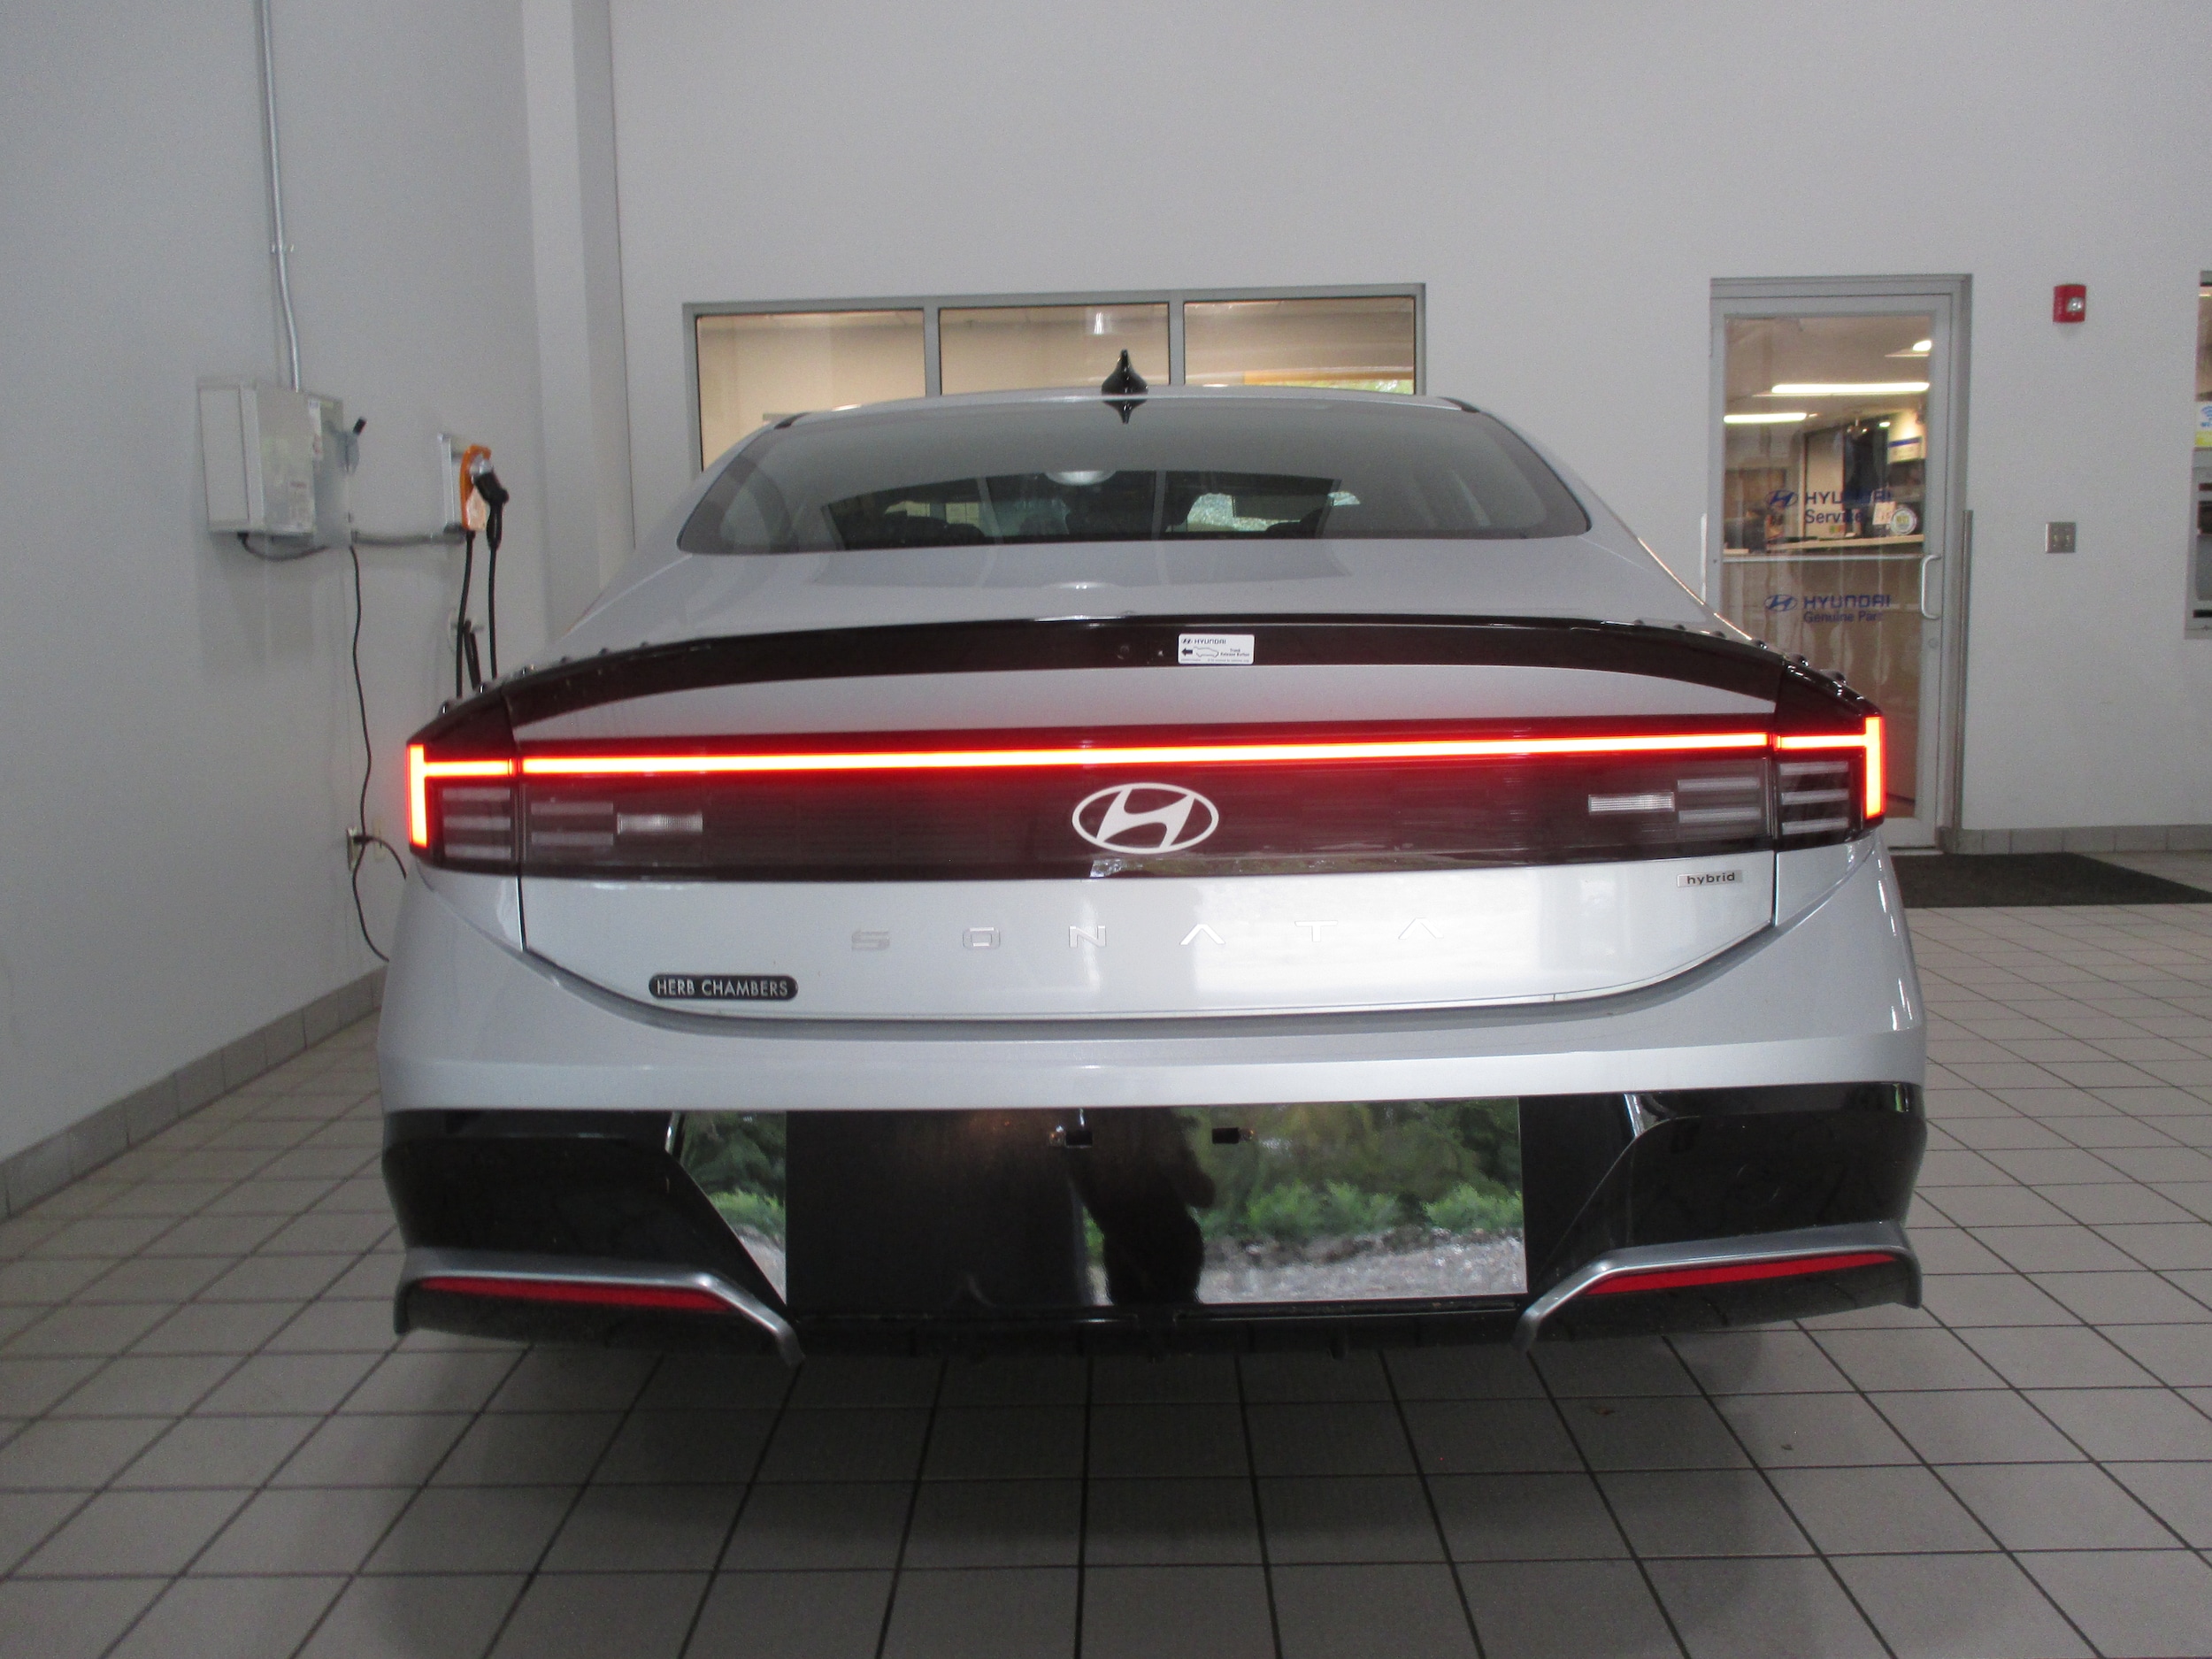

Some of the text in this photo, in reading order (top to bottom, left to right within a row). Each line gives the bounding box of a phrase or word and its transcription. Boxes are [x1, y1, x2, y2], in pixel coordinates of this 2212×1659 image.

[1805, 491, 1891, 503] HYUAI
[1806, 509, 1863, 524] Serve
[1803, 595, 1891, 609] HYUNDAI
[1803, 611, 1855, 623] Genuine
[1686, 872, 1735, 885] hybrid
[851, 917, 1444, 951] SONATA
[657, 979, 788, 996] HERB CHAMBERS
